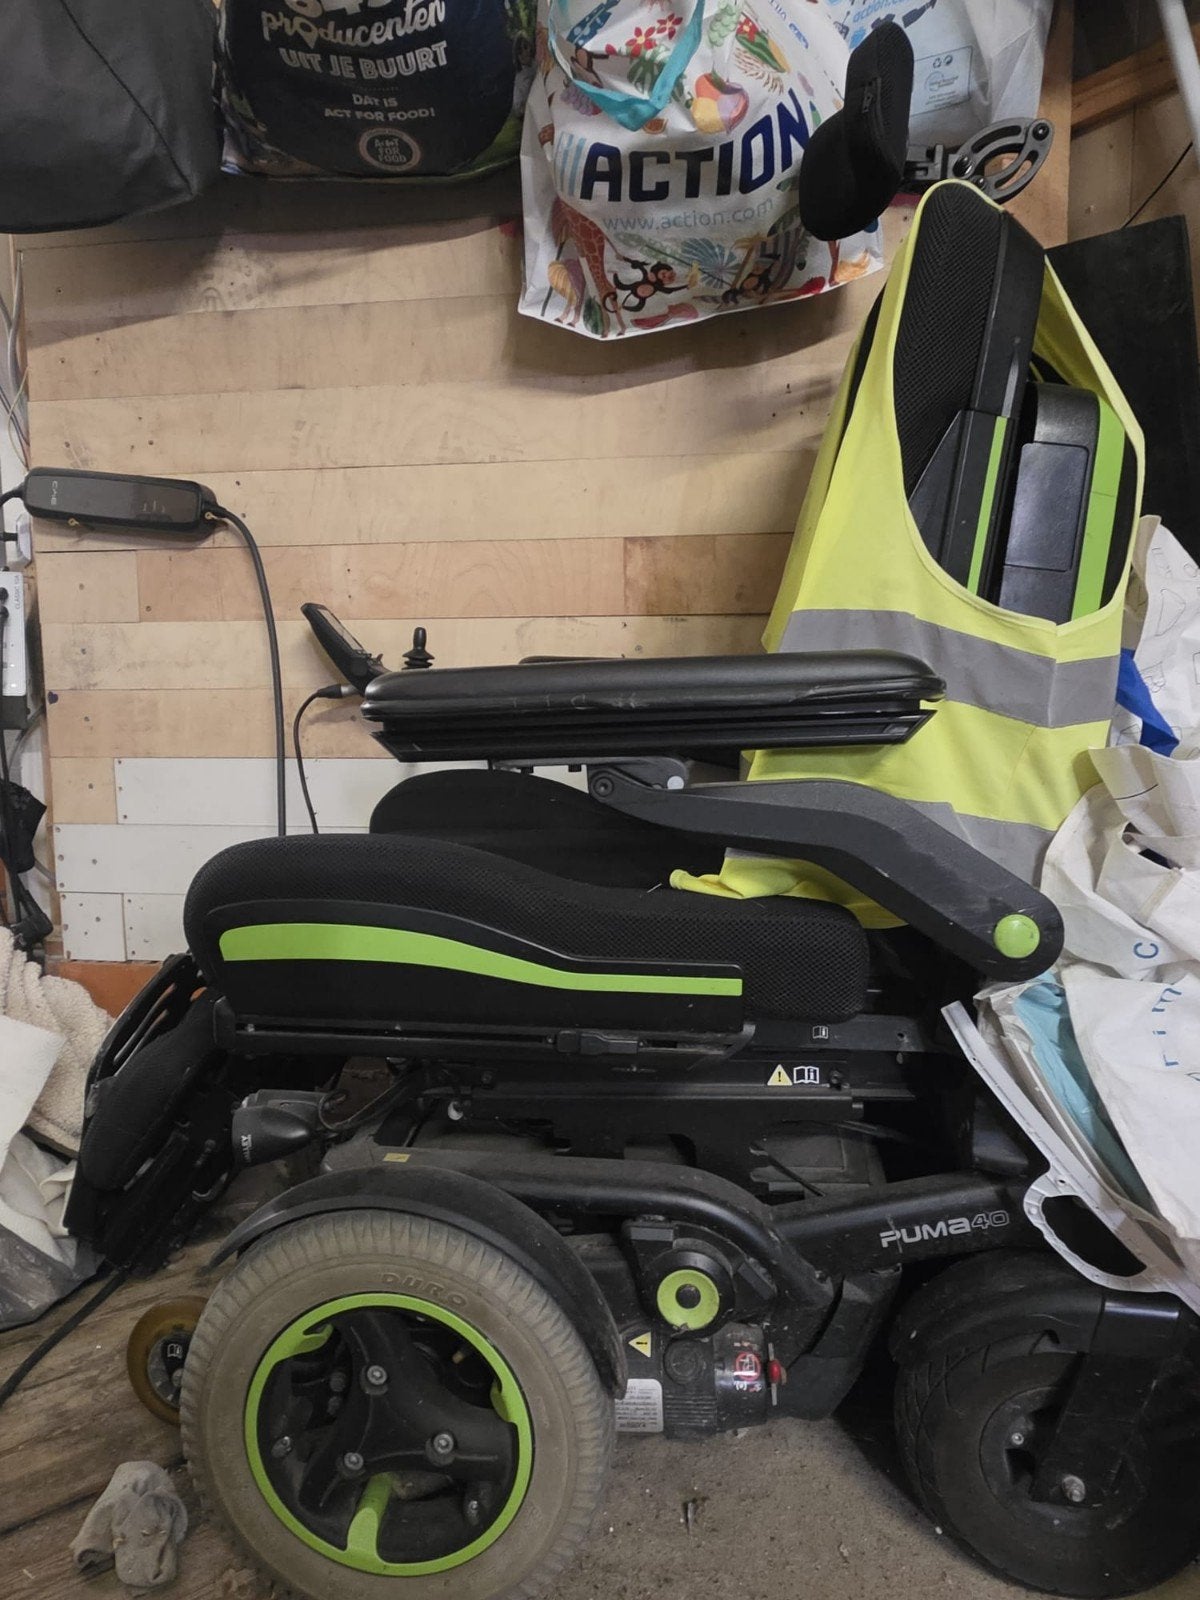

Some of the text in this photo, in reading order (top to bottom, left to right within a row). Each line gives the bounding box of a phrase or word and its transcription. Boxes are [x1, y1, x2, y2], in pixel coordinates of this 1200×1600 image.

[261, 0, 446, 49] producenten
[279, 40, 448, 80] UIT JE BUURT
[324, 106, 436, 122] ACT FOR FOOD!
[352, 93, 398, 108] DAT IS
[580, 87, 810, 202] ACTION
[602, 198, 774, 232] www.action.com
[379, 1271, 469, 1308] DURO
